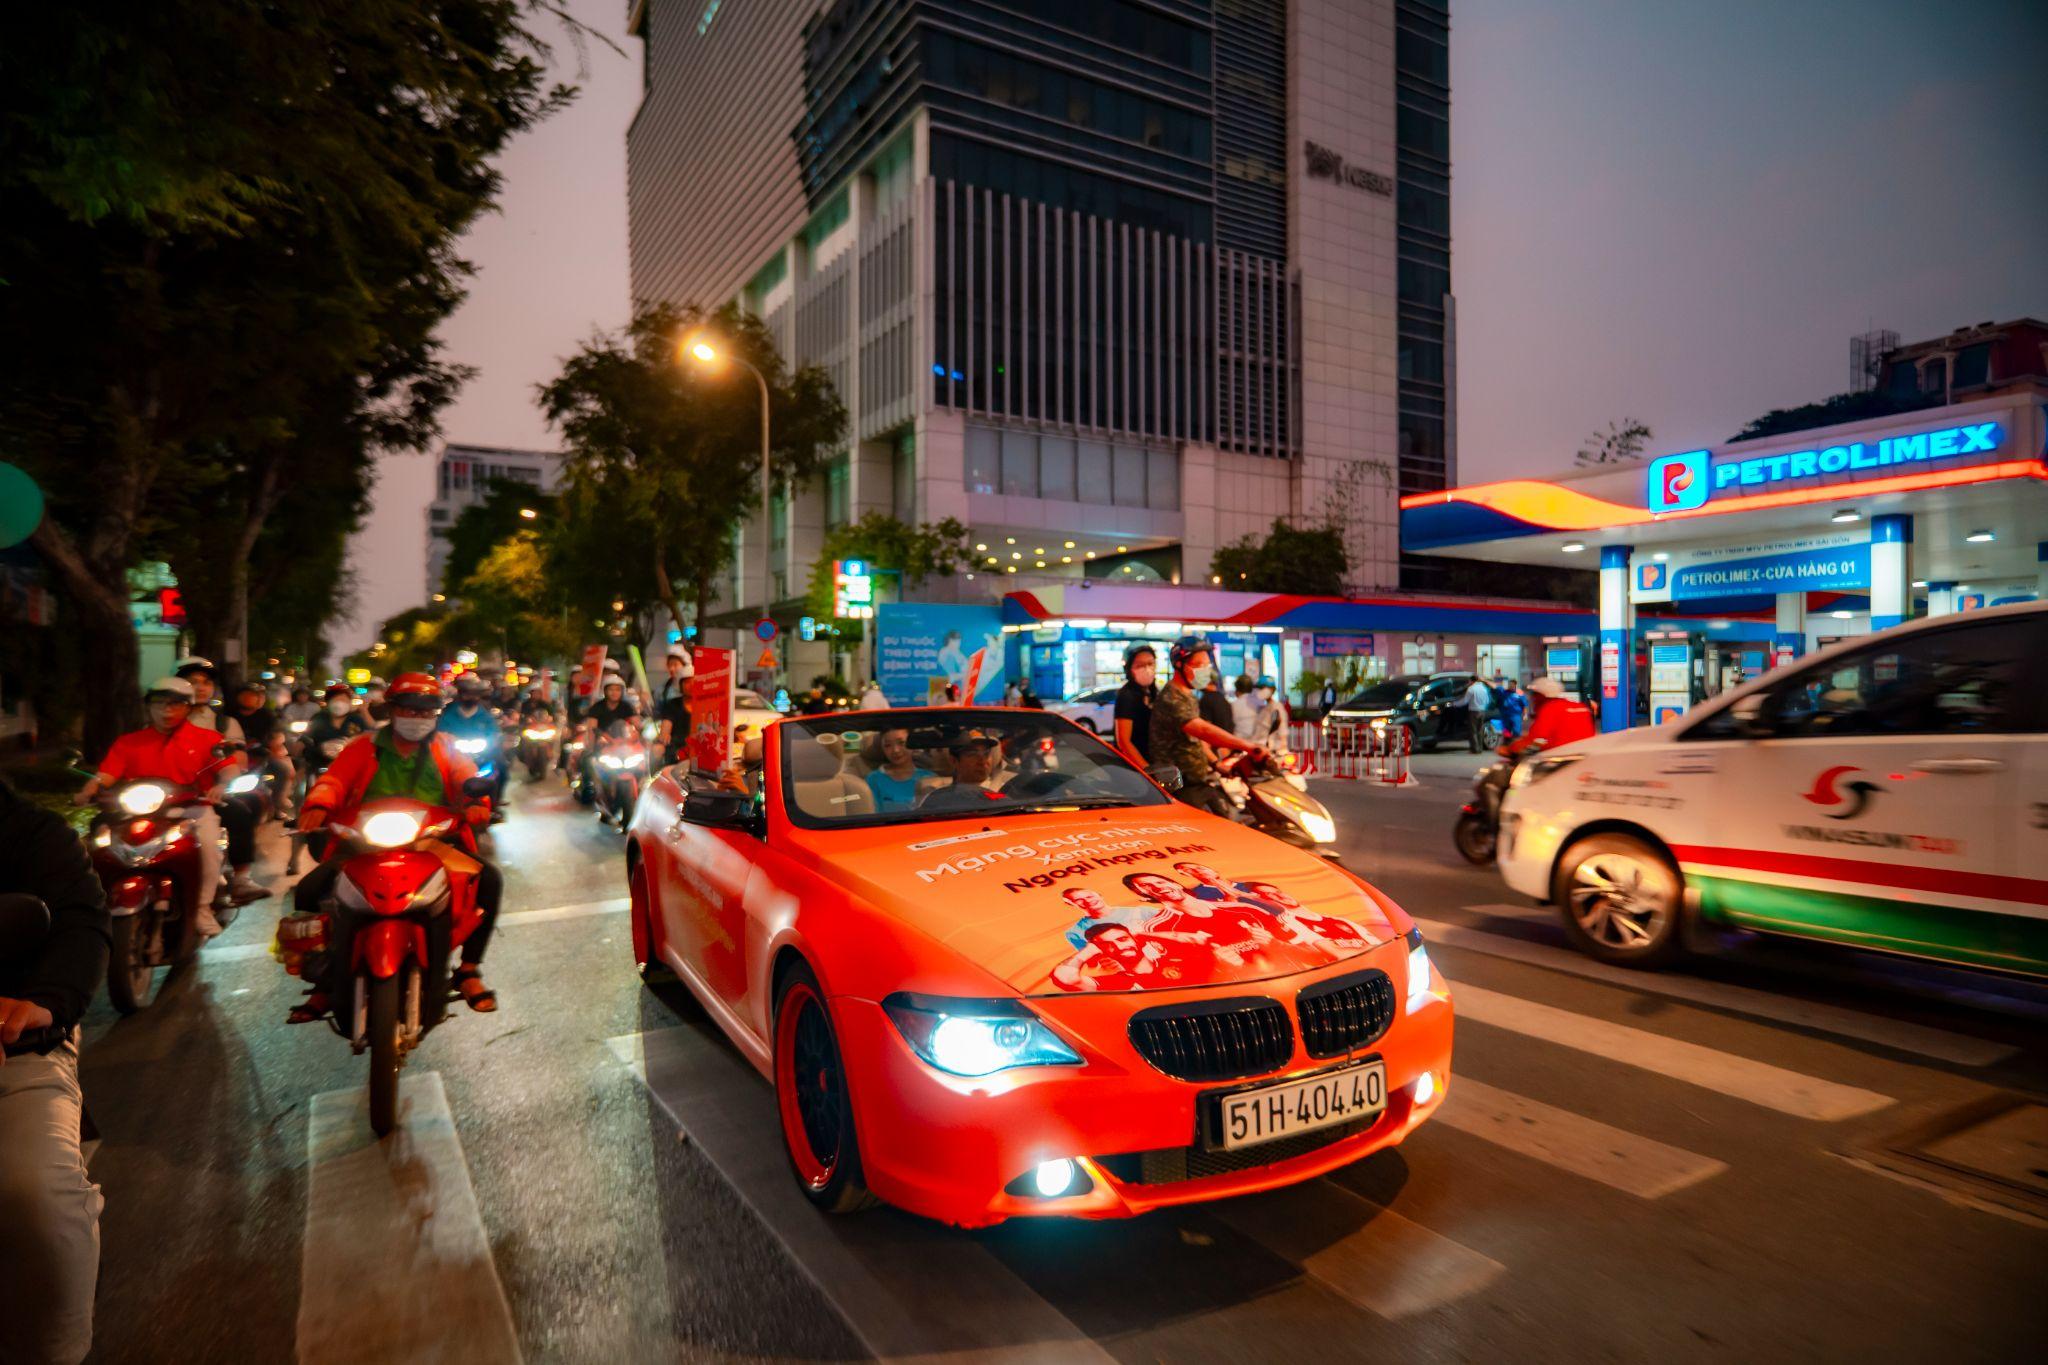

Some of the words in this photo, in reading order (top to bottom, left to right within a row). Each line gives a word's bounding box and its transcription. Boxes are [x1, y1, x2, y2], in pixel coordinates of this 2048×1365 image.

[1715, 422, 1998, 489] PETROLIMEX
[1763, 541, 1813, 551] PETROLIMEX
[1798, 559, 1838, 577] HÀNG
[1841, 560, 1856, 575] 01
[915, 844, 1037, 883] Mạng
[1037, 830, 1100, 848] cực
[1098, 822, 1203, 841] nhanh
[1003, 858, 1095, 893] Ngoại
[1091, 847, 1168, 868] hạng
[1165, 842, 1215, 857] Anh
[1034, 844, 1100, 866] Xem
[1098, 838, 1153, 854] trọn
[1230, 1071, 1380, 1140] 51H-404.40
